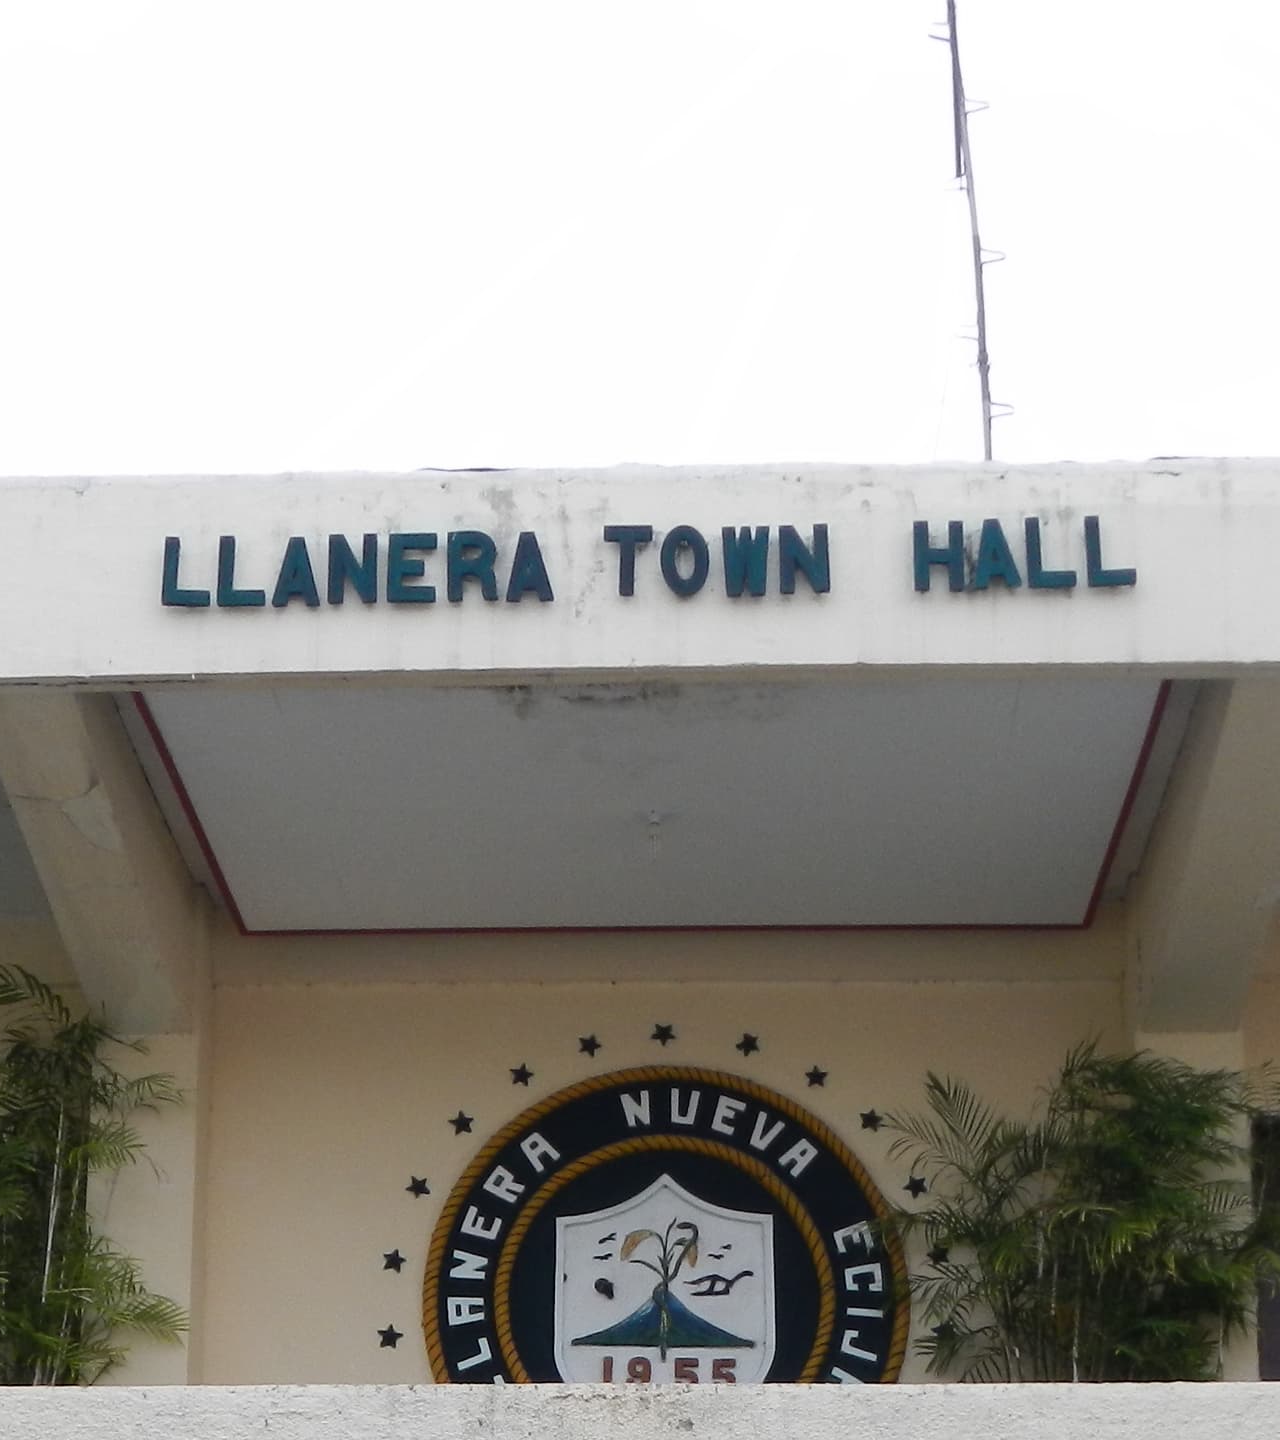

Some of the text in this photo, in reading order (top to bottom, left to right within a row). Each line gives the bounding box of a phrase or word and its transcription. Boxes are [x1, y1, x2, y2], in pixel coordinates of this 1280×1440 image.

[161, 516, 1138, 608] LLANERA TOWN HALL
[447, 1132, 561, 1383] LANERA
[621, 1087, 818, 1178] NUEVA
[602, 1356, 736, 1384] 1955
